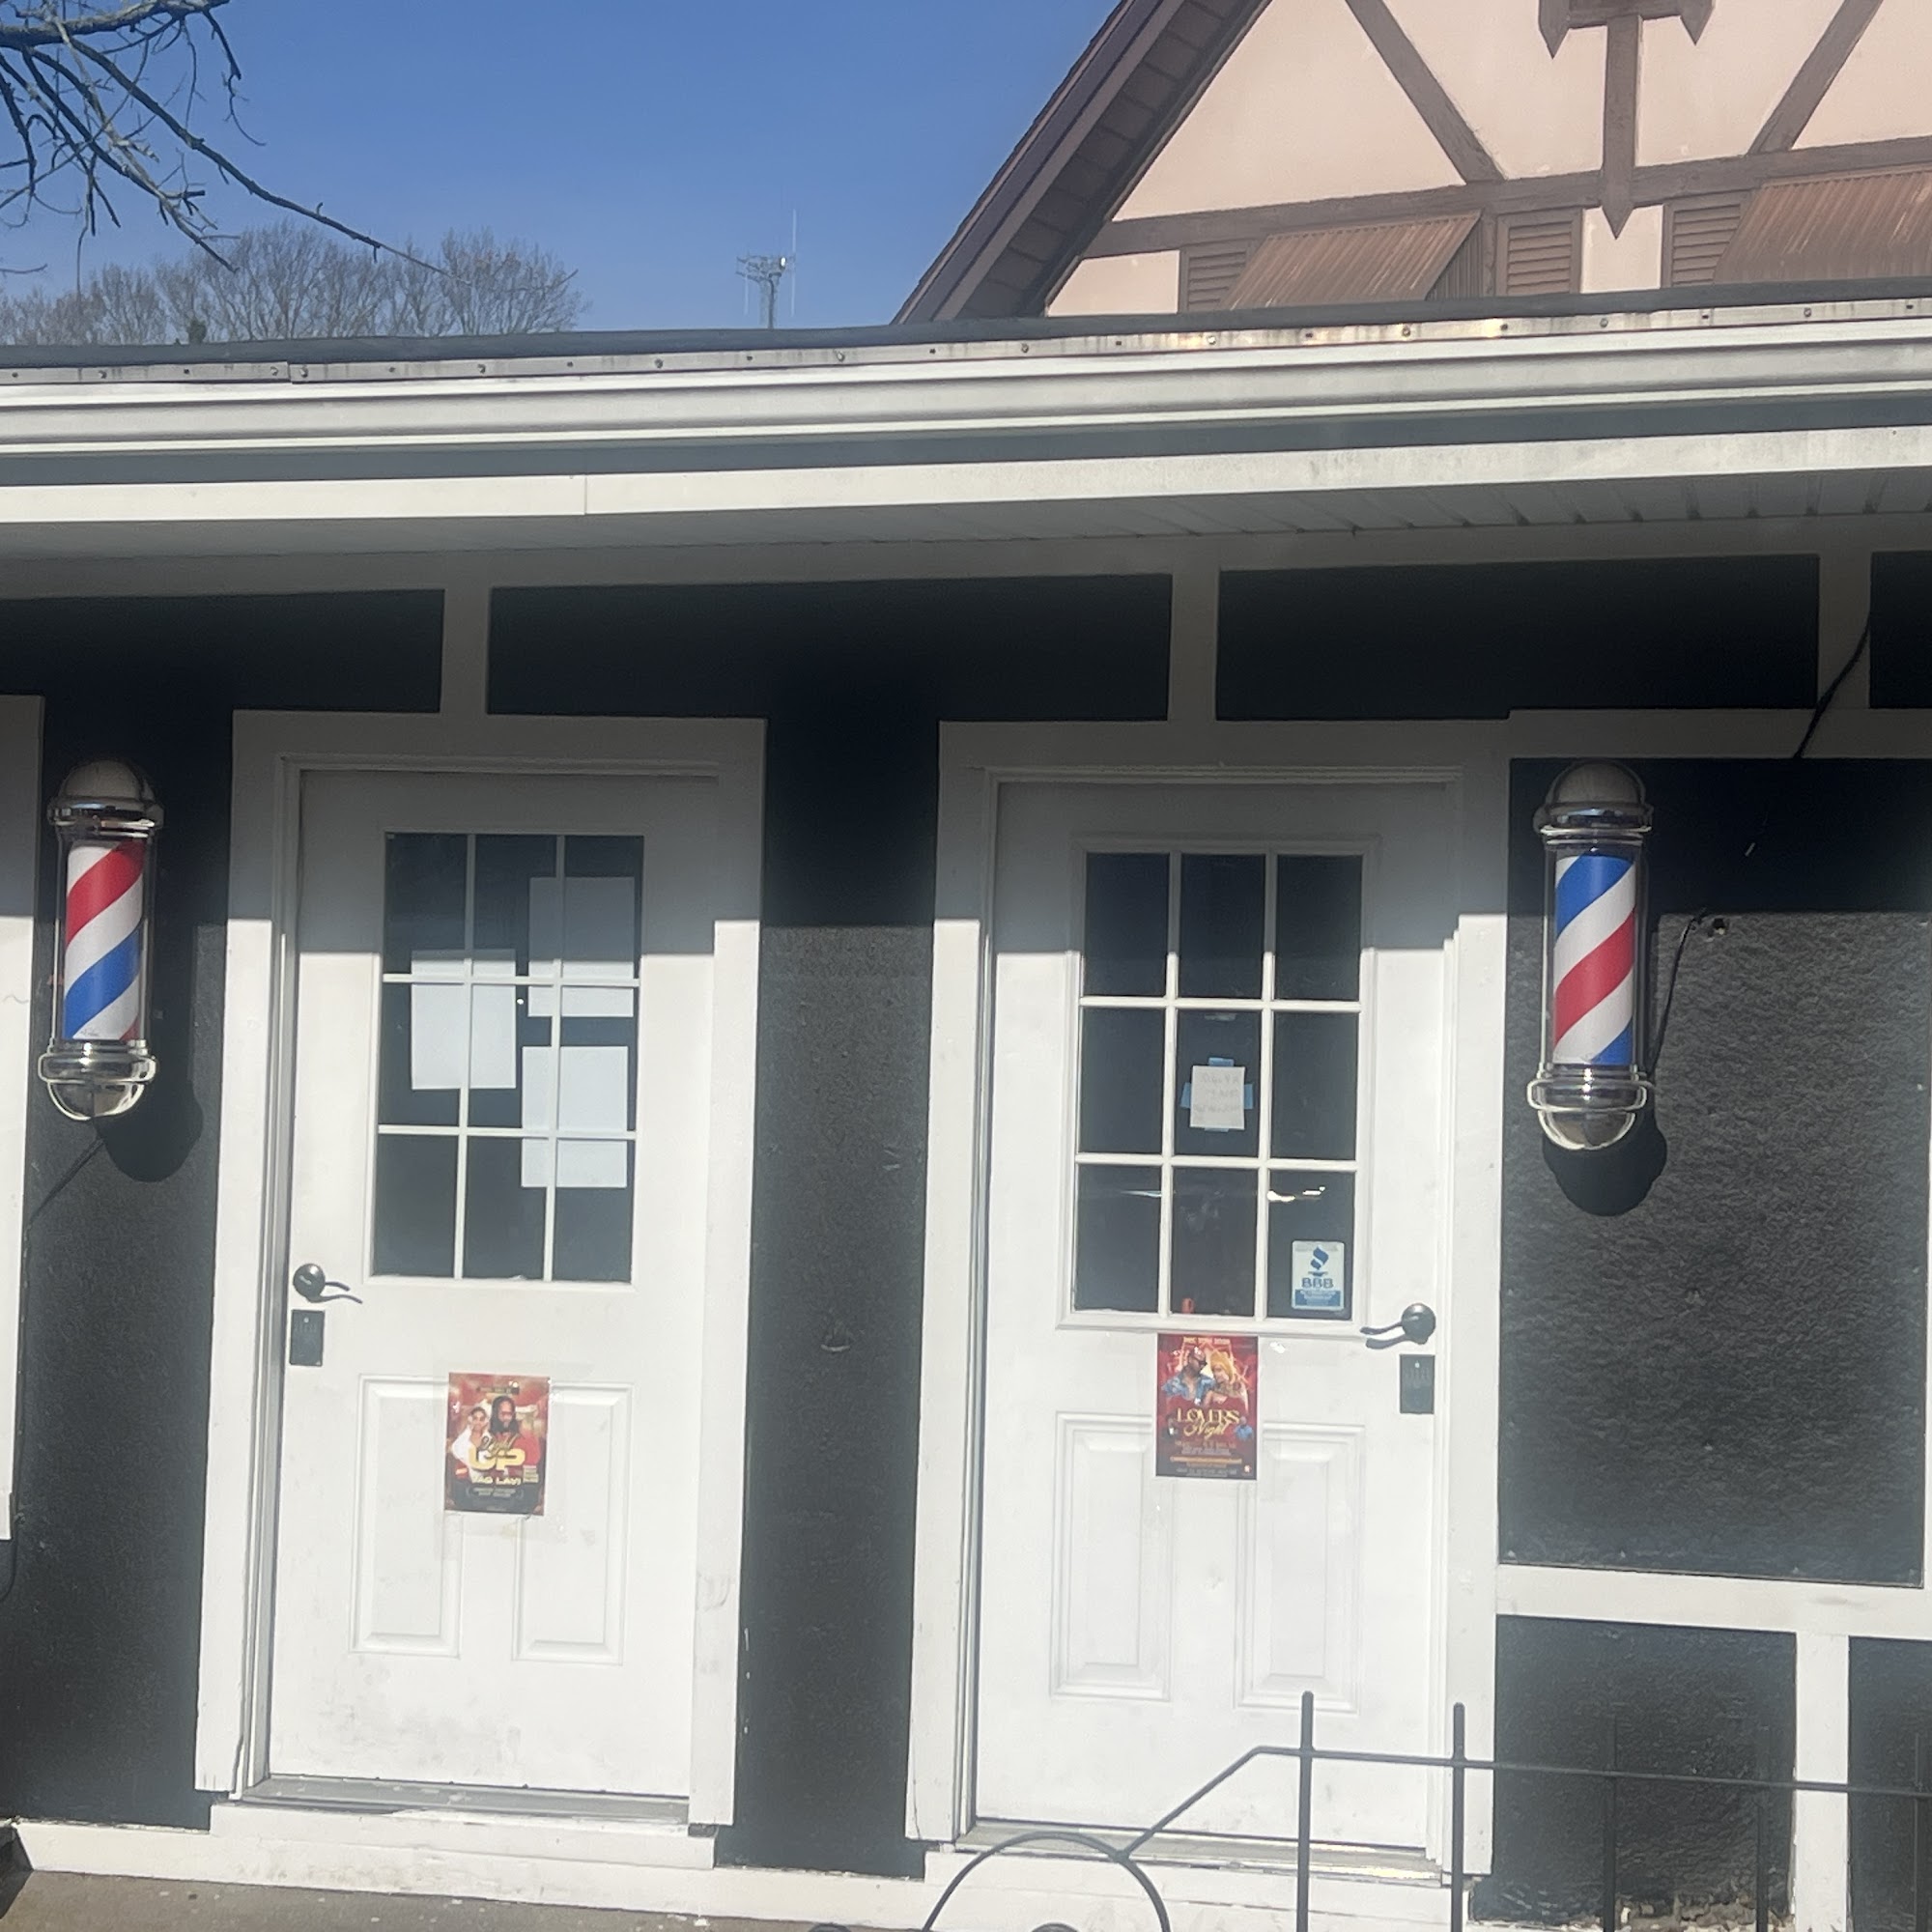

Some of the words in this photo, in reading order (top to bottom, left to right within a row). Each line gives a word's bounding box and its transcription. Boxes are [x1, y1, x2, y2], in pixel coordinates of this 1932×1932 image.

[1301, 1278, 1333, 1289] BBB
[1177, 1407, 1240, 1424] LOVERS
[1183, 1419, 1233, 1440] Night
[469, 1447, 526, 1470] UP
